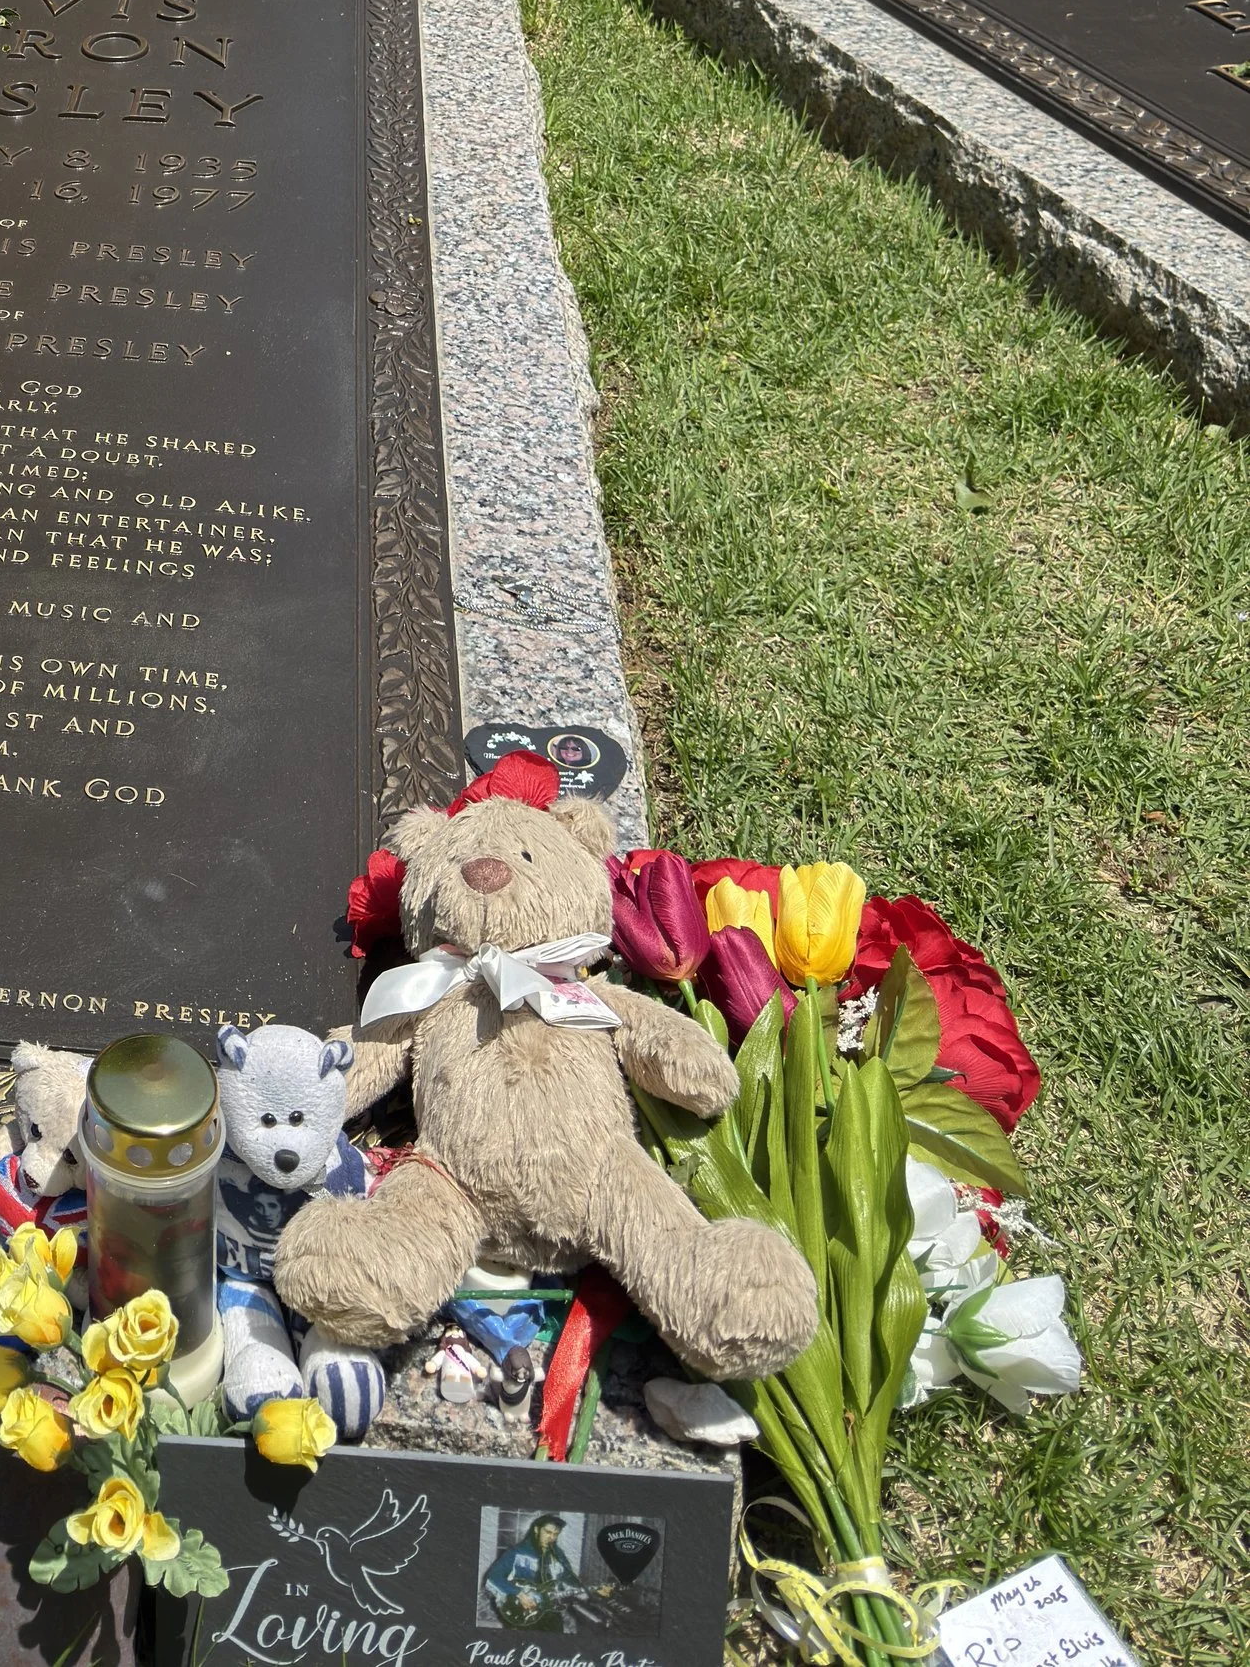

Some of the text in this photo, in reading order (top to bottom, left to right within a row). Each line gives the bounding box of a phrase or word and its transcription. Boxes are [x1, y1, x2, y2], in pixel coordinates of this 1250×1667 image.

[61, 148, 101, 174] 8,
[134, 151, 259, 182] 1935
[28, 178, 89, 205] 16,
[128, 182, 259, 214] 1977
[0, 217, 29, 230] OF
[70, 240, 257, 270] PRESLEY
[51, 283, 245, 314] PRESLEY
[6, 332, 207, 366] PRESLEY
[1, 424, 78, 442] THAT
[95, 431, 129, 446] HE
[145, 435, 257, 457] SHARED
[8, 600, 113, 623] MUSIC
[130, 611, 202, 630] AND
[61, 717, 137, 737] AND
[133, 999, 278, 1028] PRESLEY
[284, 1582, 310, 1598] IN
[990, 1591, 1028, 1612] May
[1034, 1586, 1069, 1610] 2025
[211, 1558, 429, 1667] Loving
[465, 1641, 515, 1666] Paul
[1059, 1632, 1104, 1659] Elvis
